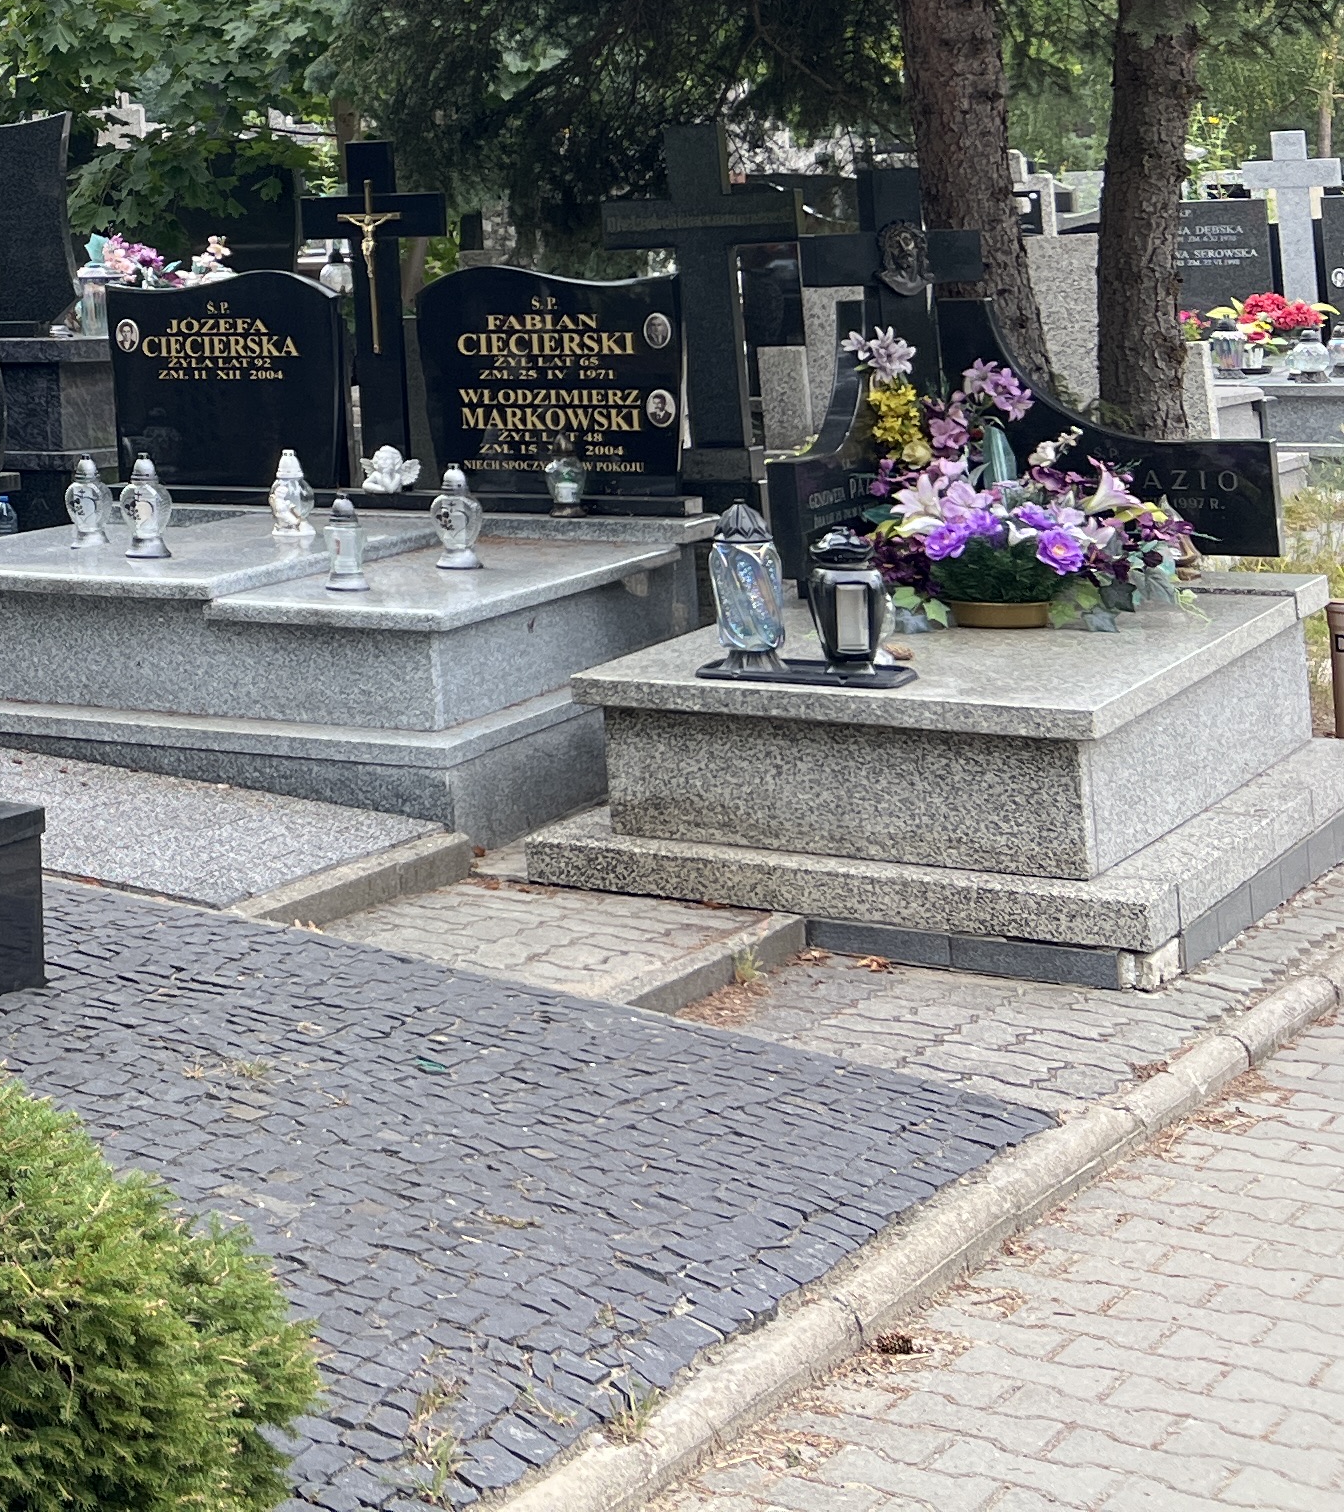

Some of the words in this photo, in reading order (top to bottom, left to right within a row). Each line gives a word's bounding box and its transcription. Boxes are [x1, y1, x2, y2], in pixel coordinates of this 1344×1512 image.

[166, 316, 269, 334] JÓZEFA
[486, 313, 599, 331] FABIAN
[141, 335, 301, 357] CIECIERSKA
[457, 332, 636, 356] CIECIERSKI
[217, 358, 251, 368] LAT
[254, 358, 272, 368] 92
[537, 356, 575, 367] LAT
[579, 356, 600, 367] 65
[158, 370, 189, 380] ZM.
[193, 370, 208, 380] 11
[216, 370, 242, 380] XII
[249, 370, 284, 380] 2004
[479, 369, 513, 380] ZM.
[518, 369, 538, 380] 25
[546, 369, 568, 380] IV
[579, 369, 615, 380] 1971
[458, 388, 641, 406] WŁODZIMIERZ
[461, 406, 642, 432] MARKOWSKI
[541, 431, 580, 442] LT
[583, 432, 604, 442] 48
[479, 443, 514, 455] ZM.
[520, 444, 538, 455] 15
[585, 444, 625, 456] 2004
[463, 458, 500, 471] NIECH
[596, 461, 645, 473] POKOJU
[1143, 469, 1239, 492] AZIO
